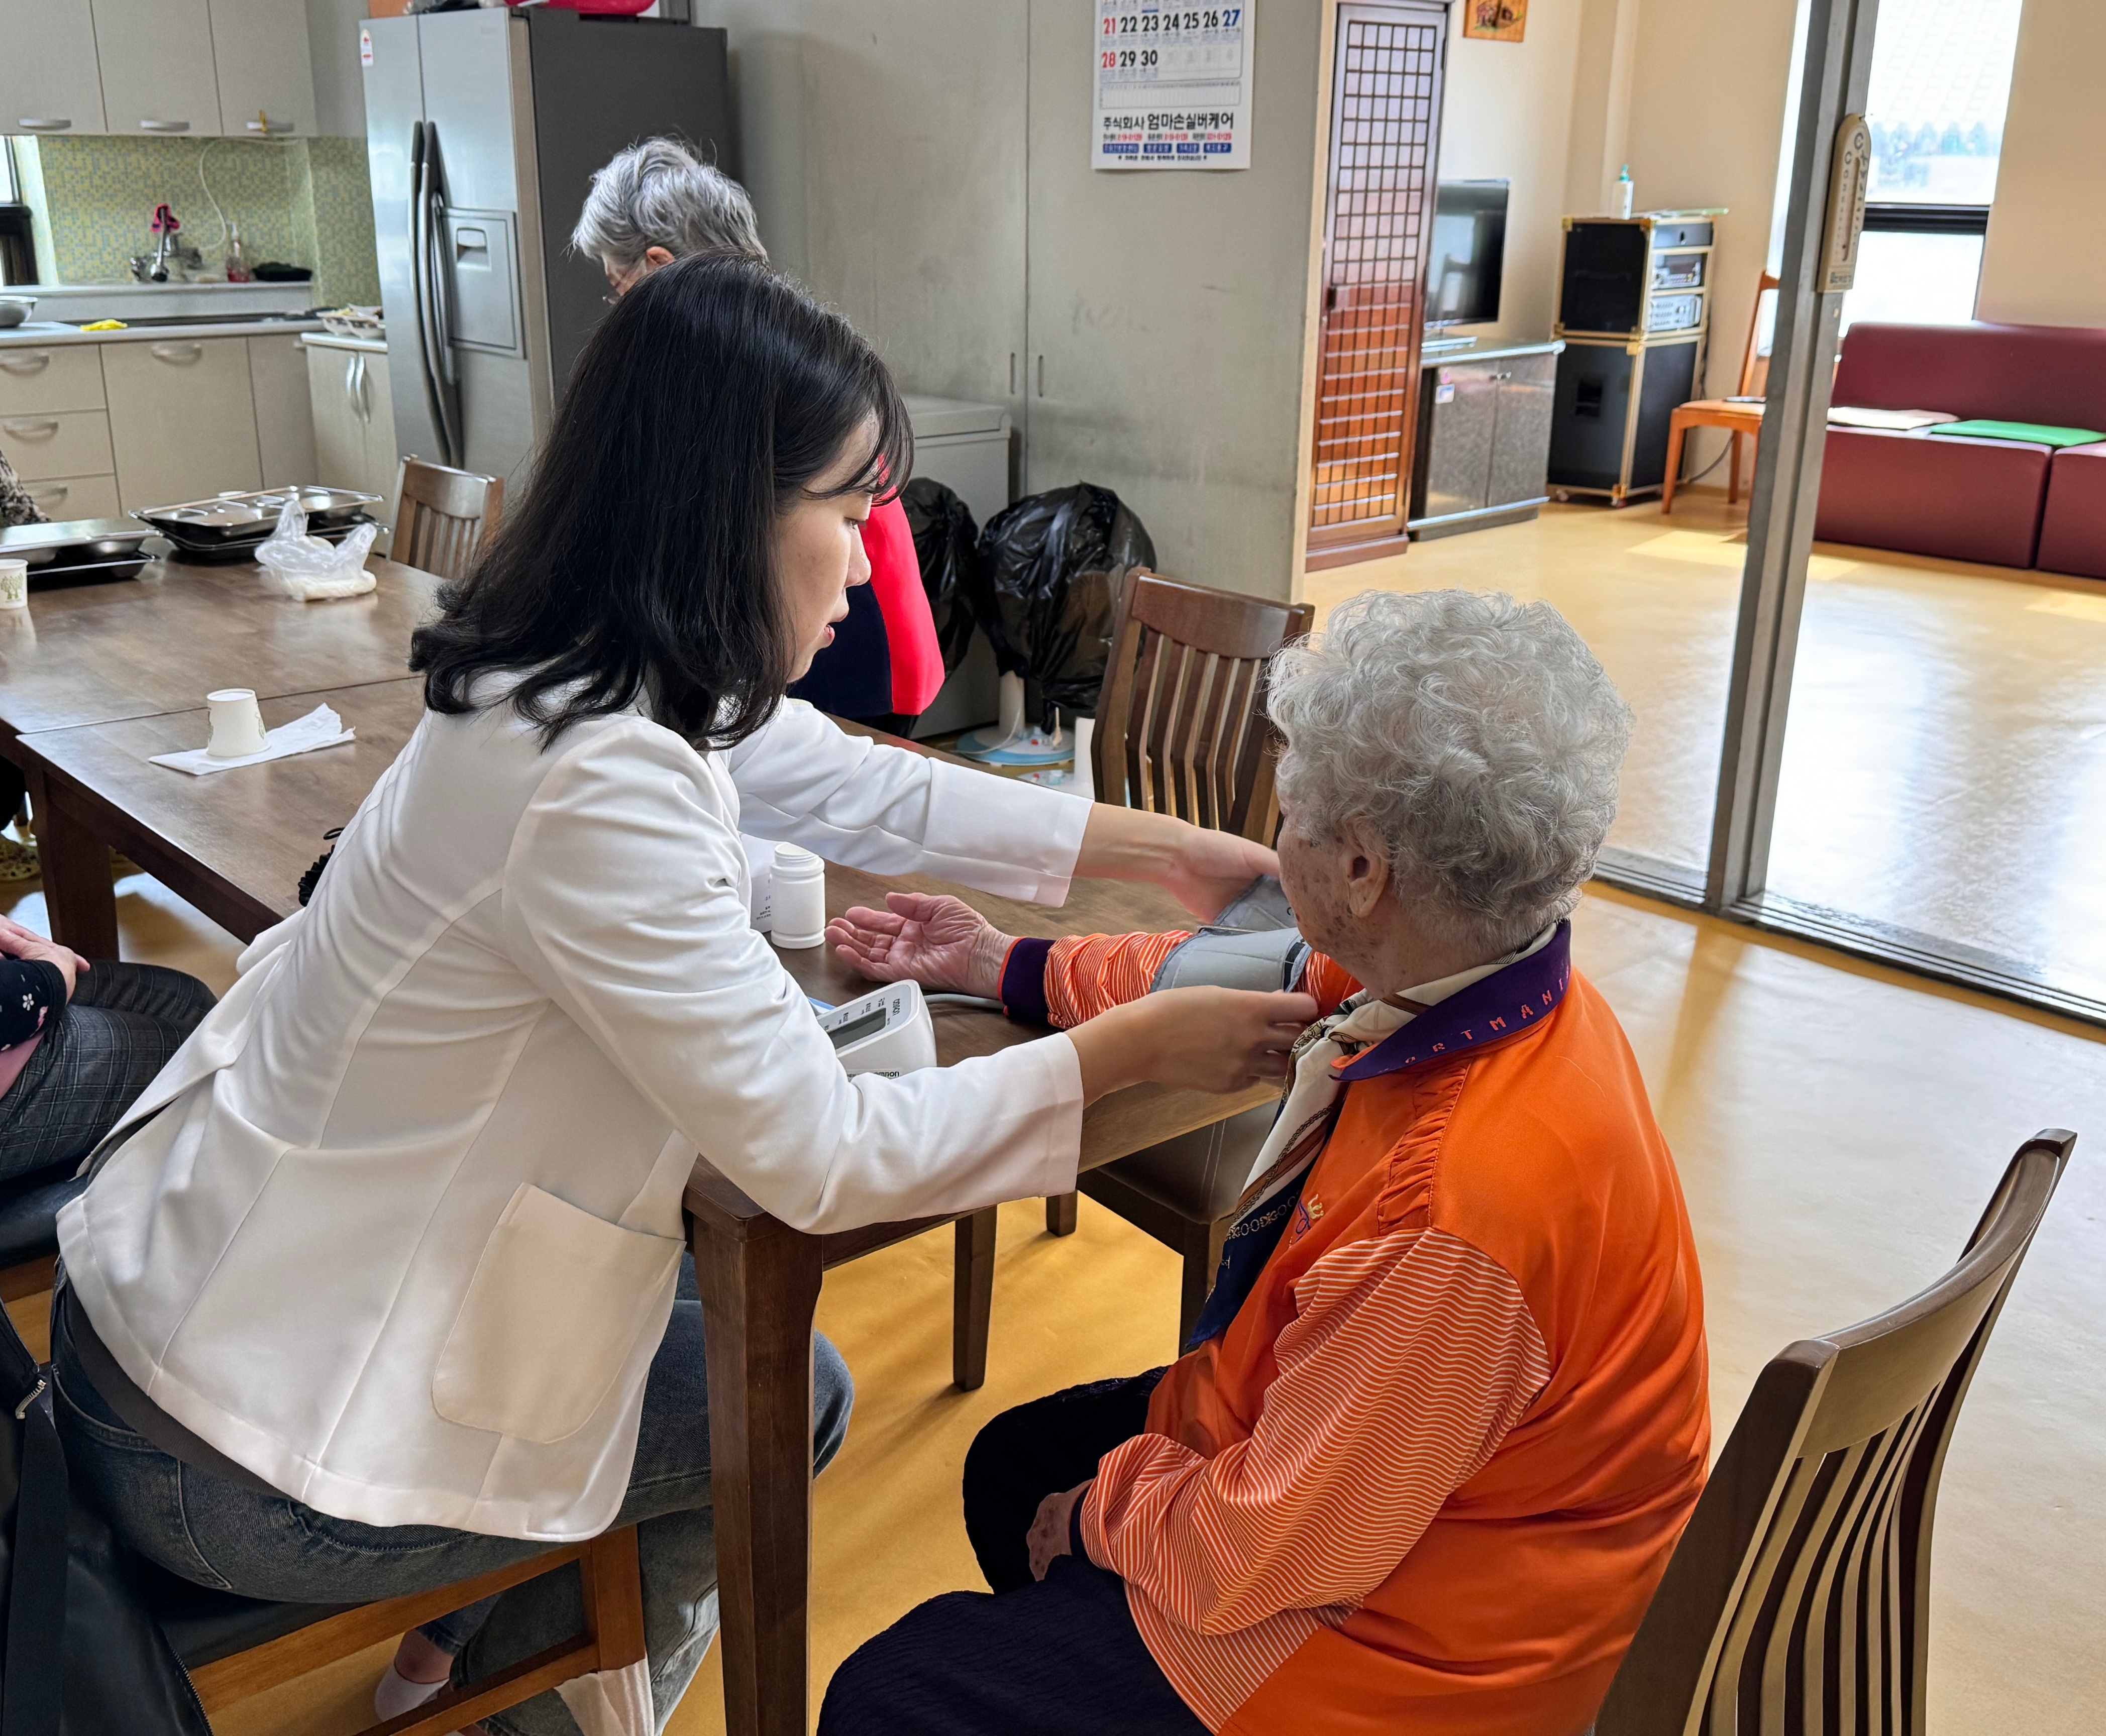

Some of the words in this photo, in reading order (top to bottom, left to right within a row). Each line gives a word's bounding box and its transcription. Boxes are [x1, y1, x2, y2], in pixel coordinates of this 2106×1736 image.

[1103, 18, 1116, 34] 21
[1120, 16, 1137, 33] 22
[1141, 15, 1159, 32] 23
[1163, 13, 1179, 31] 24
[1184, 13, 1199, 30] 25
[1203, 11, 1218, 28] 26
[1223, 9, 1241, 27] 27
[1102, 52, 1116, 68] 28
[1120, 51, 1136, 67] 29
[1141, 50, 1158, 66] 30
[1103, 116, 1144, 131] 주식회사
[1147, 112, 1234, 131] 엄마손실버케어
